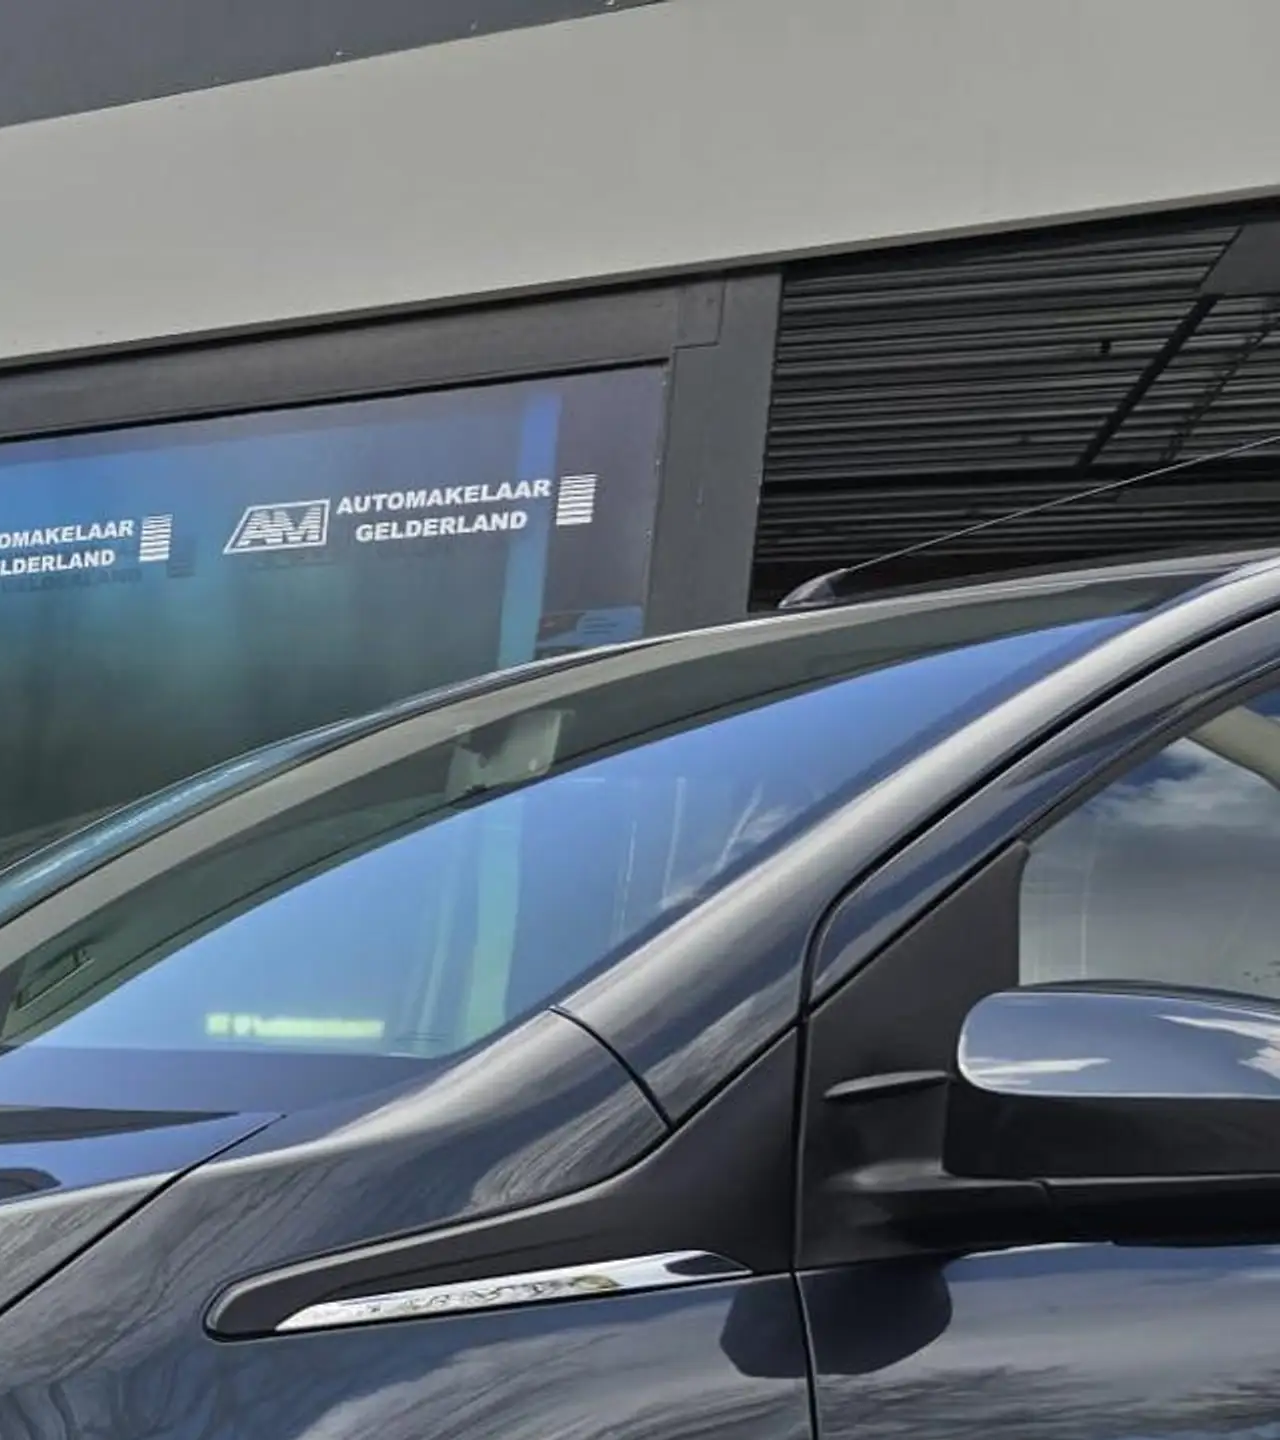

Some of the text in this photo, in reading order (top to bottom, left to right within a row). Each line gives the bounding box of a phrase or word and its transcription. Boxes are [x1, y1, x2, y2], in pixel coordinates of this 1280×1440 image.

[336, 479, 551, 514] AUTOMAKELAAR
[237, 505, 322, 547] AM
[355, 511, 527, 543] GELDERLAND
